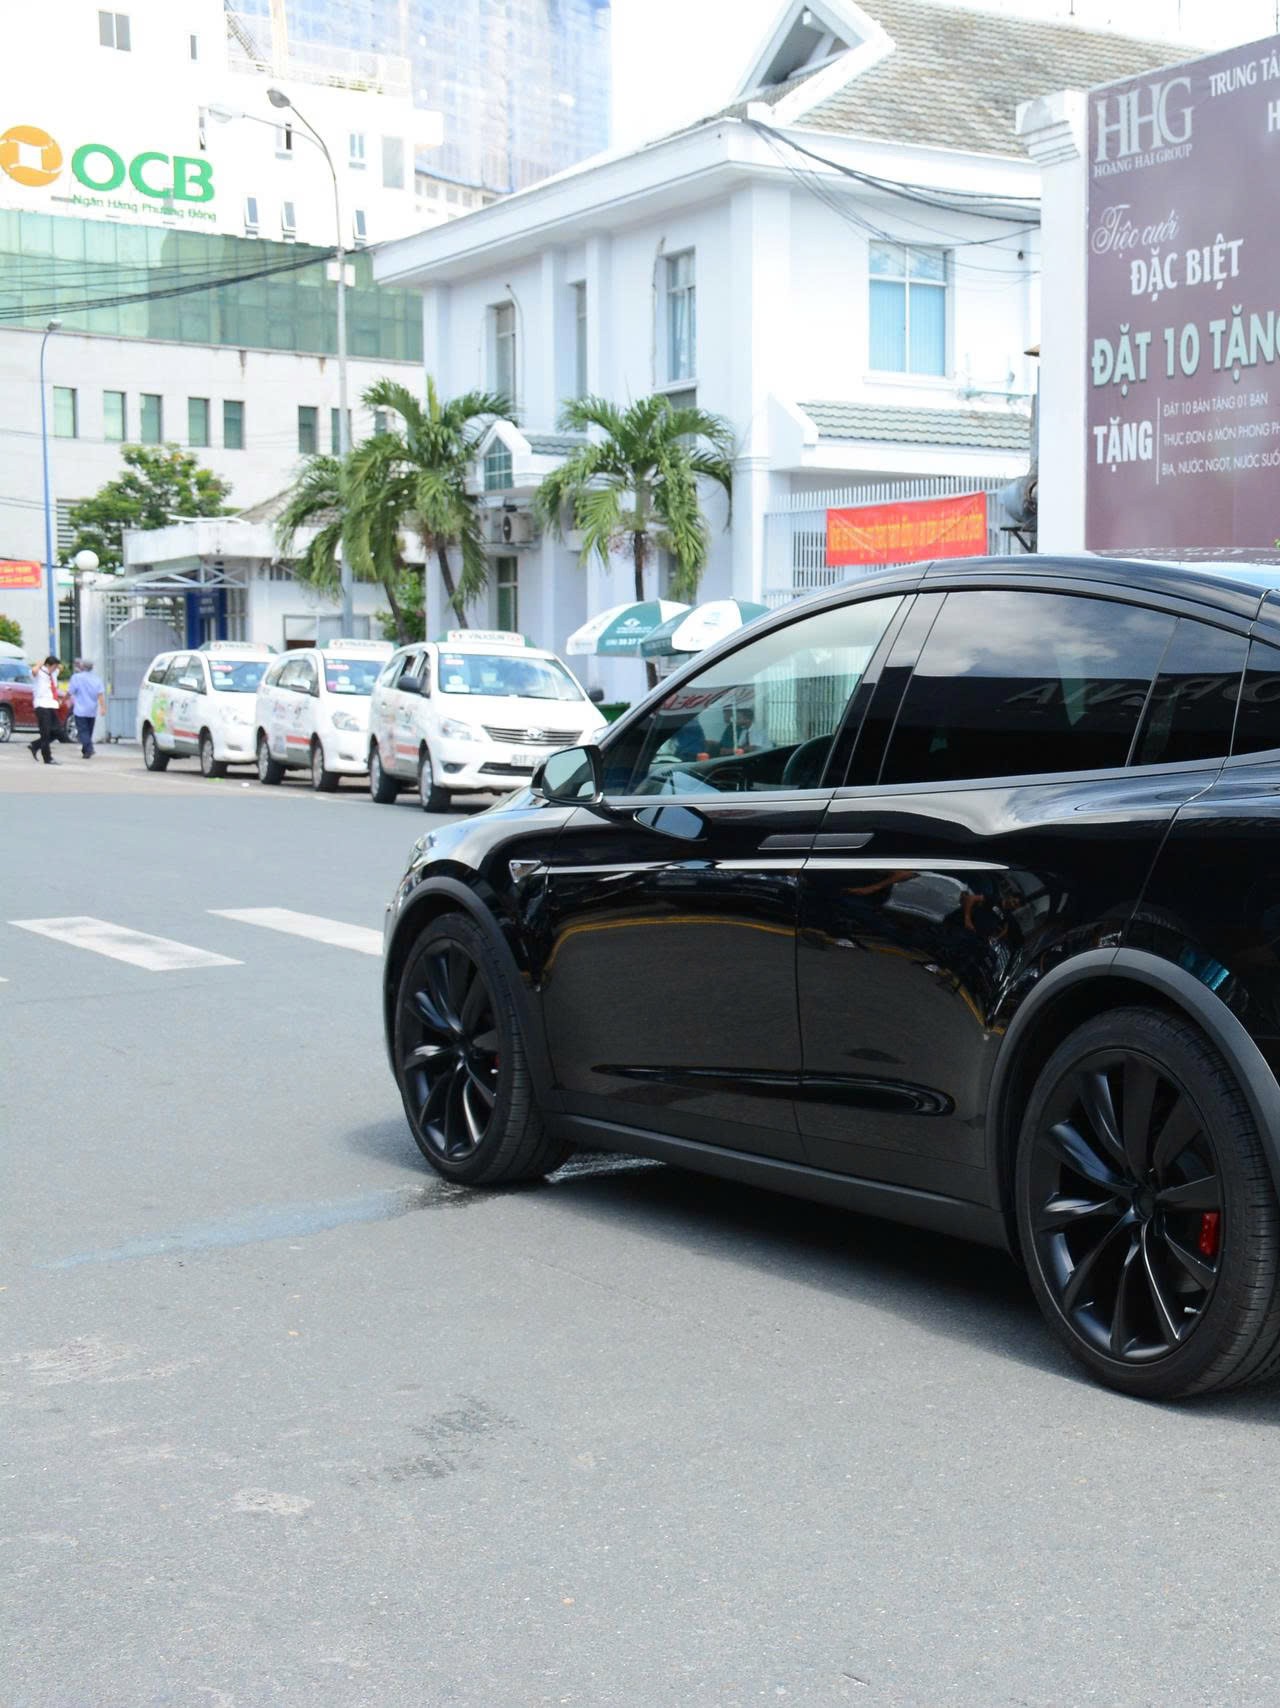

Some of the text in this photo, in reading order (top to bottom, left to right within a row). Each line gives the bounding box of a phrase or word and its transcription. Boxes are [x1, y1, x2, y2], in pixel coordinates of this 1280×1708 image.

[1208, 60, 1258, 97] TRUNG
[1094, 76, 1196, 163] HHG
[71, 142, 216, 204] OCB
[1093, 143, 1193, 178] HOANG HAI GROUP
[1130, 232, 1245, 302] ĐẶC BIỆT
[1091, 322, 1151, 397] ĐẶT
[1164, 322, 1201, 378] 10
[1093, 415, 1153, 473] TẶNG
